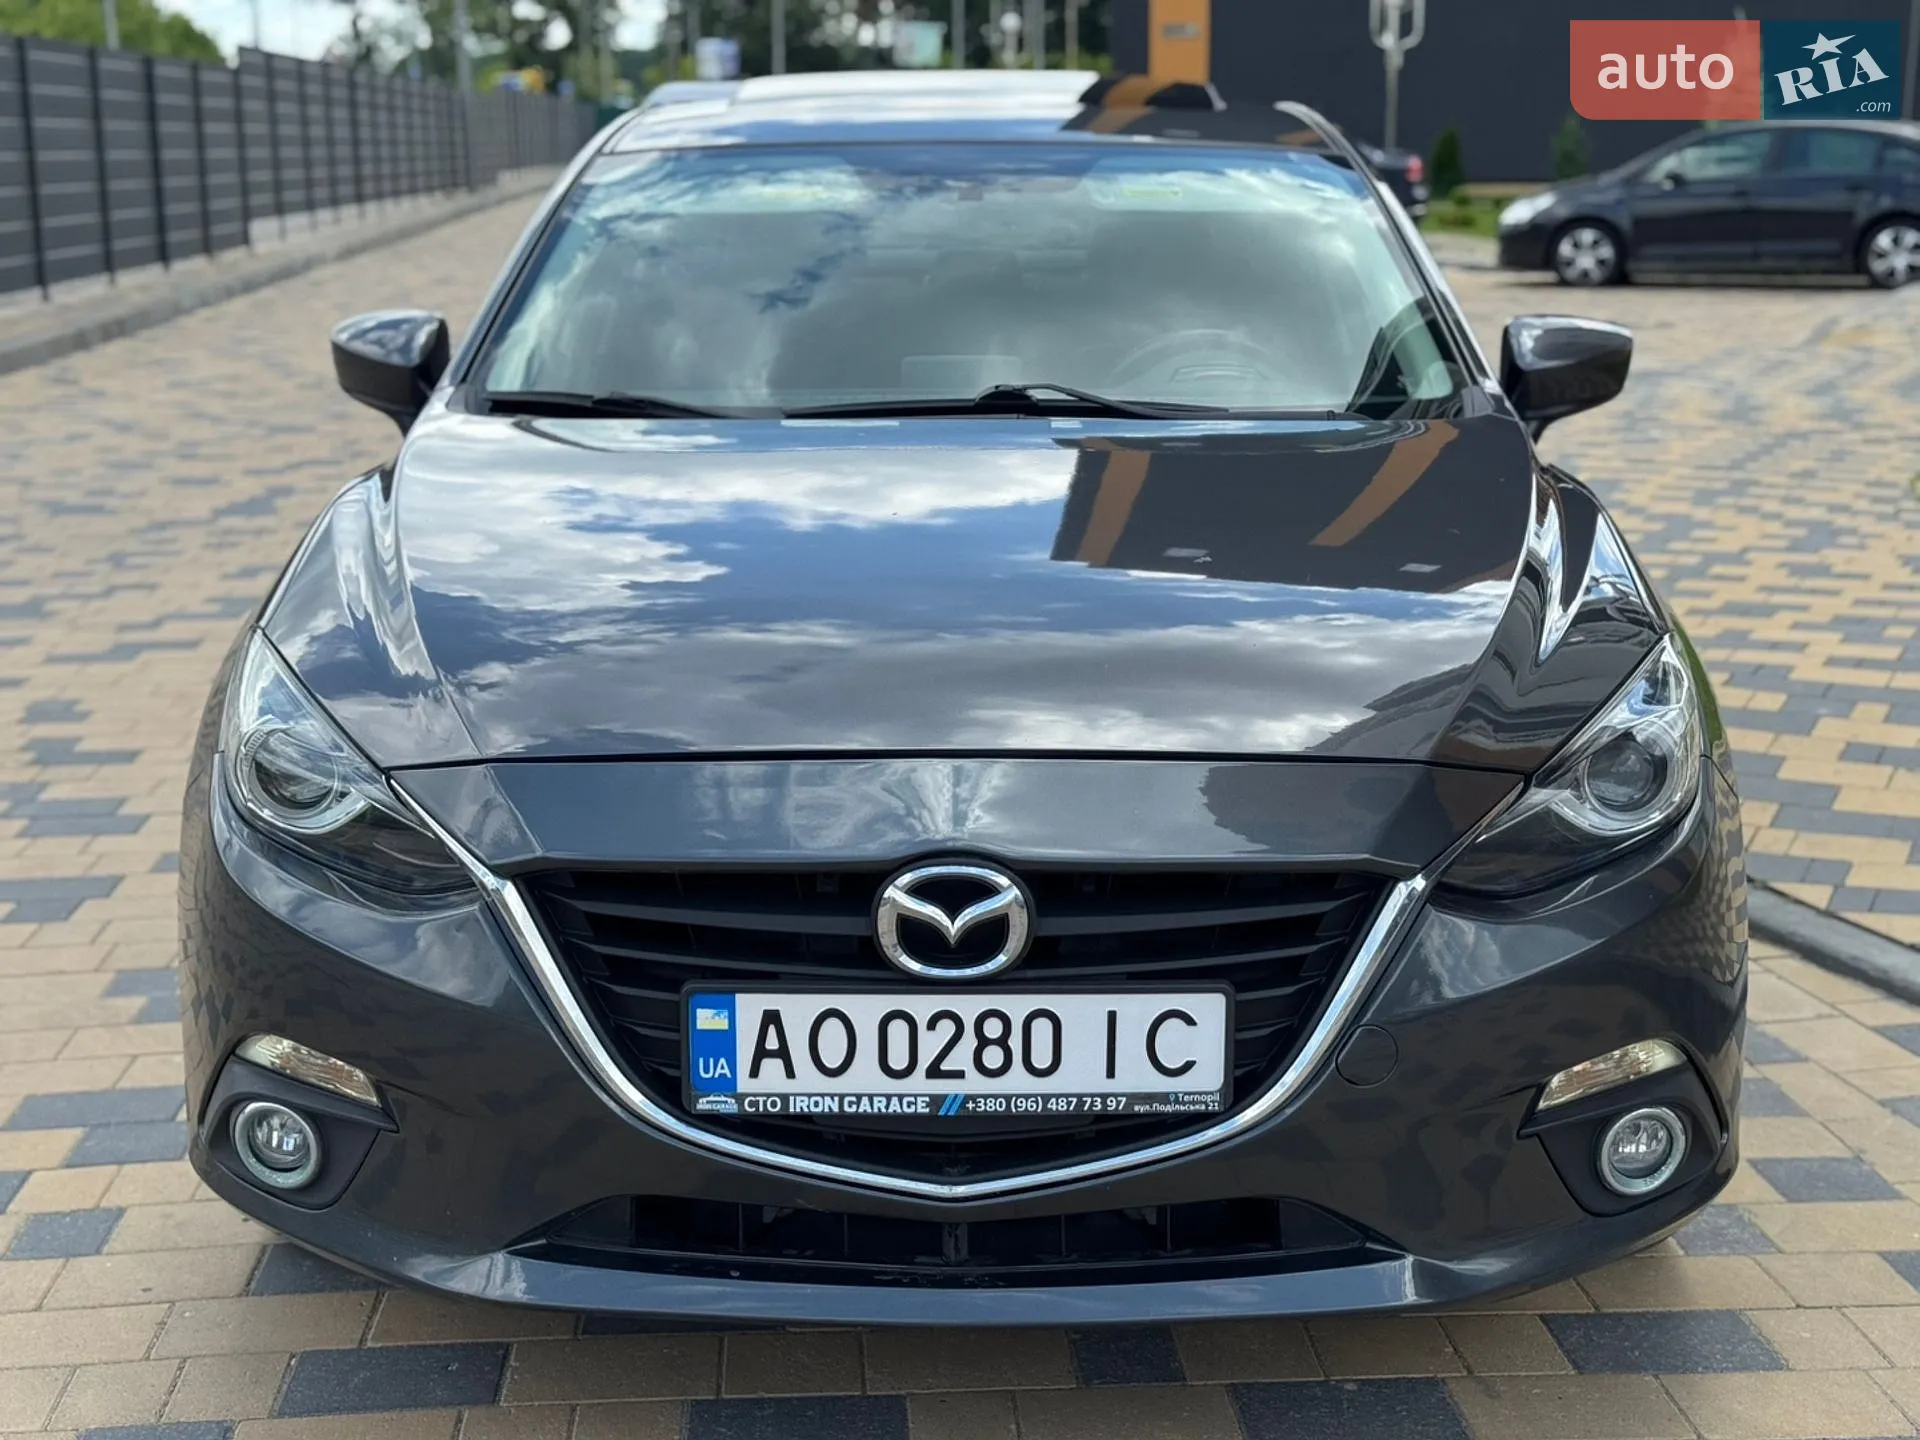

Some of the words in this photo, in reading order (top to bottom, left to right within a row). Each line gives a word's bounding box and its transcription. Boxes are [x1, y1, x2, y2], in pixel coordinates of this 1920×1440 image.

[878, 1008, 1063, 1080] 0280
[699, 1057, 732, 1079] UA
[789, 1096, 838, 1113] IRON
[843, 1096, 930, 1113] GARAGE
[965, 1097, 1006, 1112] +380
[1010, 1096, 1043, 1113] (96)
[1047, 1097, 1077, 1111] 487
[1082, 1097, 1102, 1111] 73
[1106, 1097, 1127, 1111] 97
[1177, 1092, 1220, 1103] Ternopil
